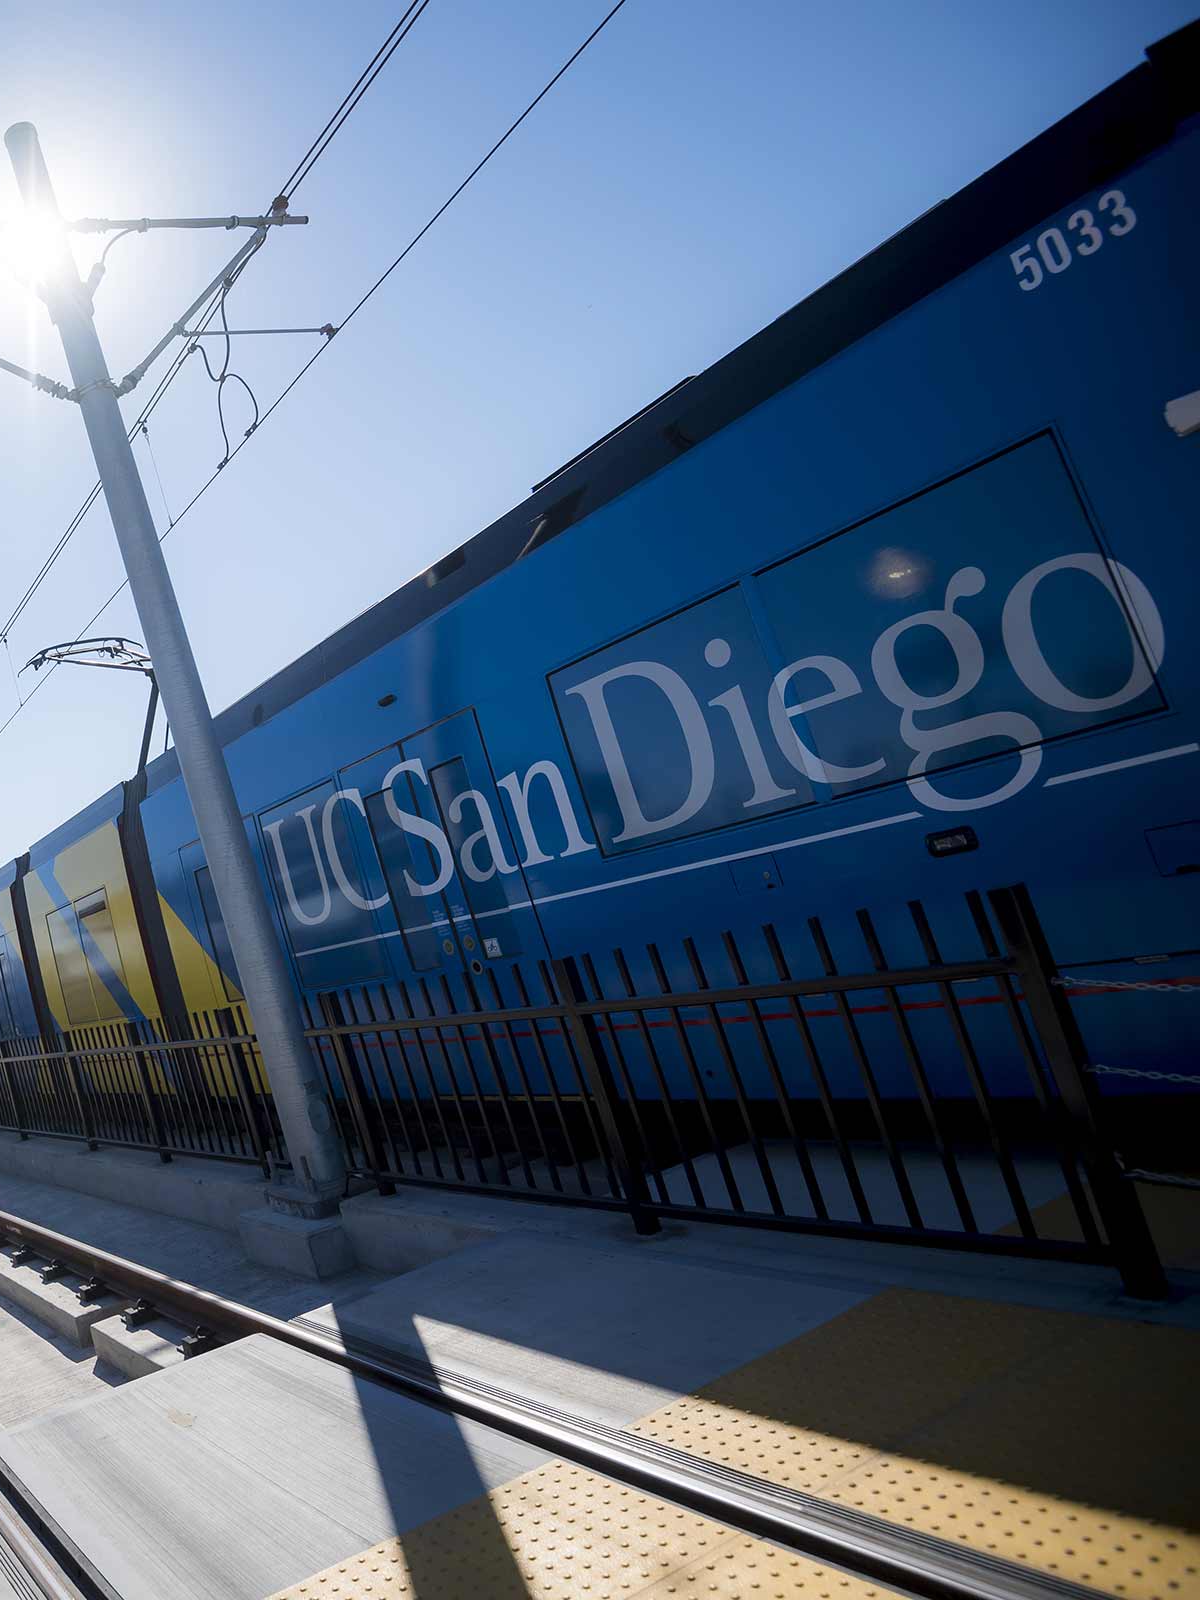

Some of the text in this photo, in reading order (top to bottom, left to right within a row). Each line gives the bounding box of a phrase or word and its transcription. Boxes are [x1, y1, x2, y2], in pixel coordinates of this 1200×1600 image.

[1009, 190, 1137, 291] 5033
[263, 552, 1165, 926] UC San Diego
